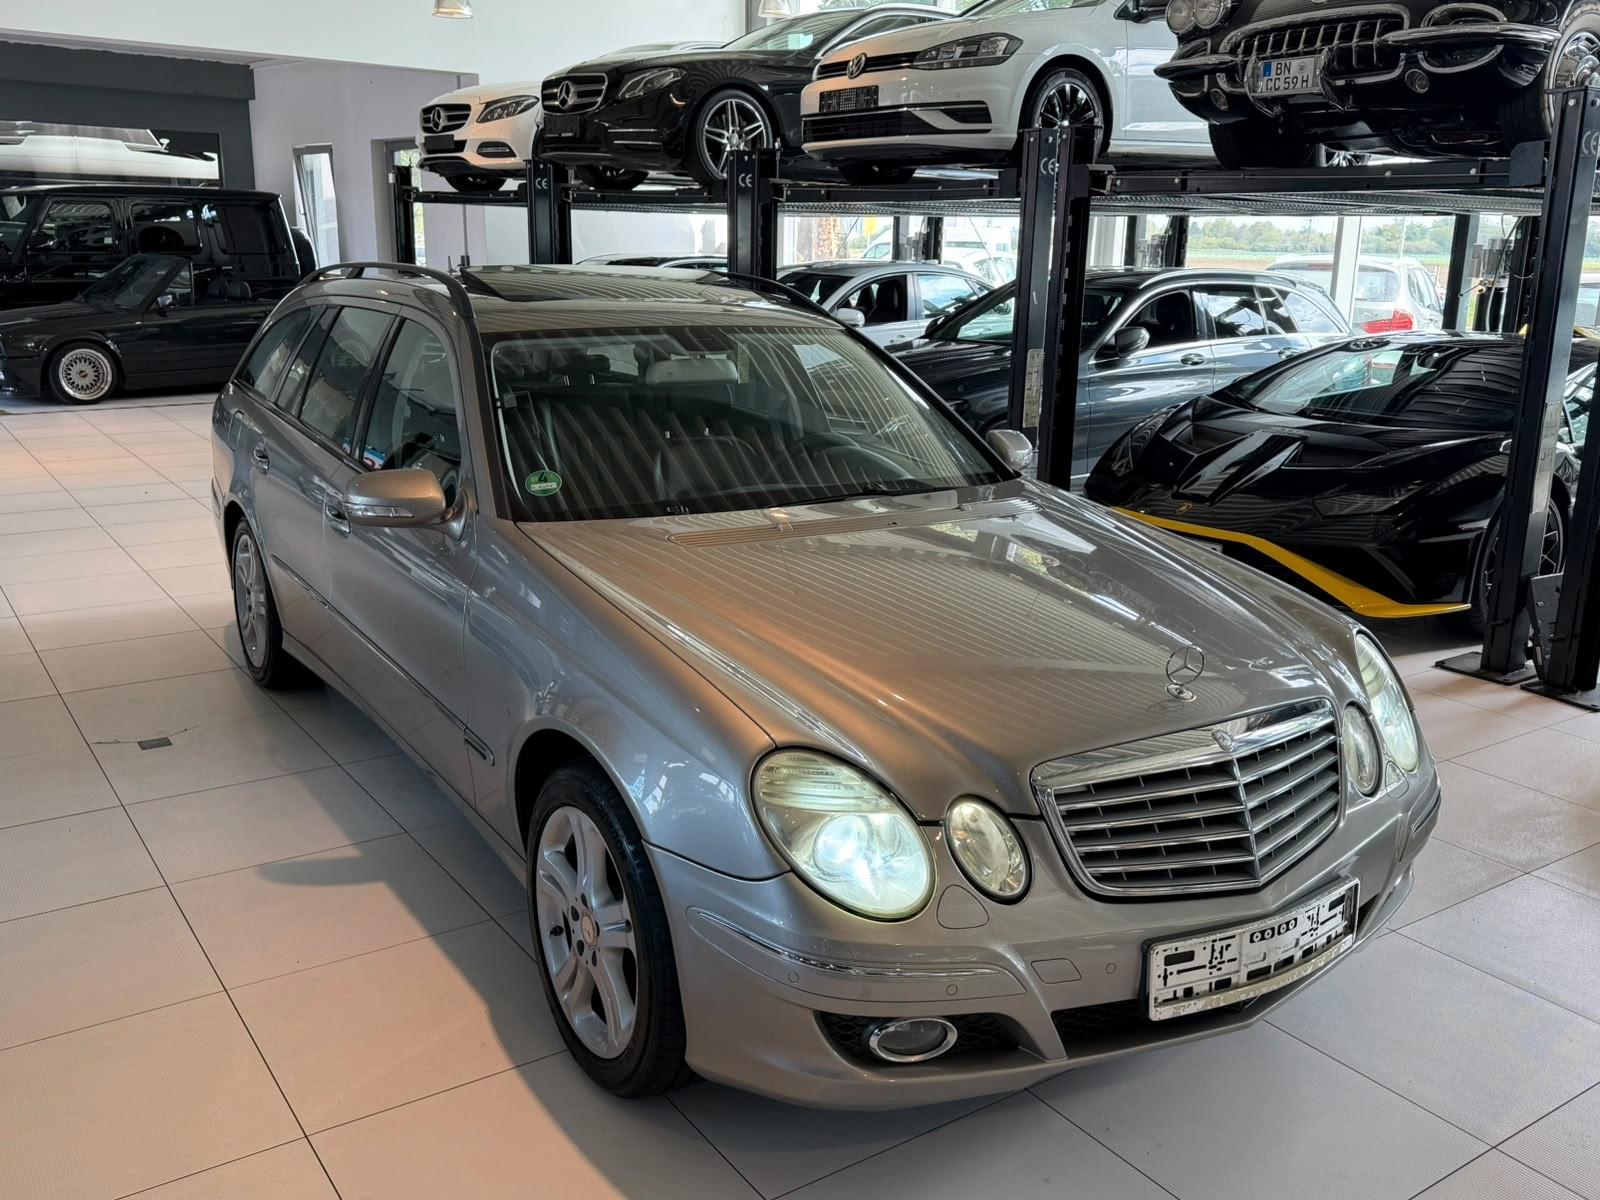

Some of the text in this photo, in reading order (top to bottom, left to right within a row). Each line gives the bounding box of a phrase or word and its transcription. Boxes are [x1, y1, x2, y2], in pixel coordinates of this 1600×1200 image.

[1275, 61, 1291, 77] BN
[1283, 75, 1298, 90] 59
[1582, 130, 1599, 155] CE
[1040, 157, 1056, 175] CE
[535, 177, 548, 190] CE
[738, 173, 752, 188] CE
[537, 471, 548, 483] 4
